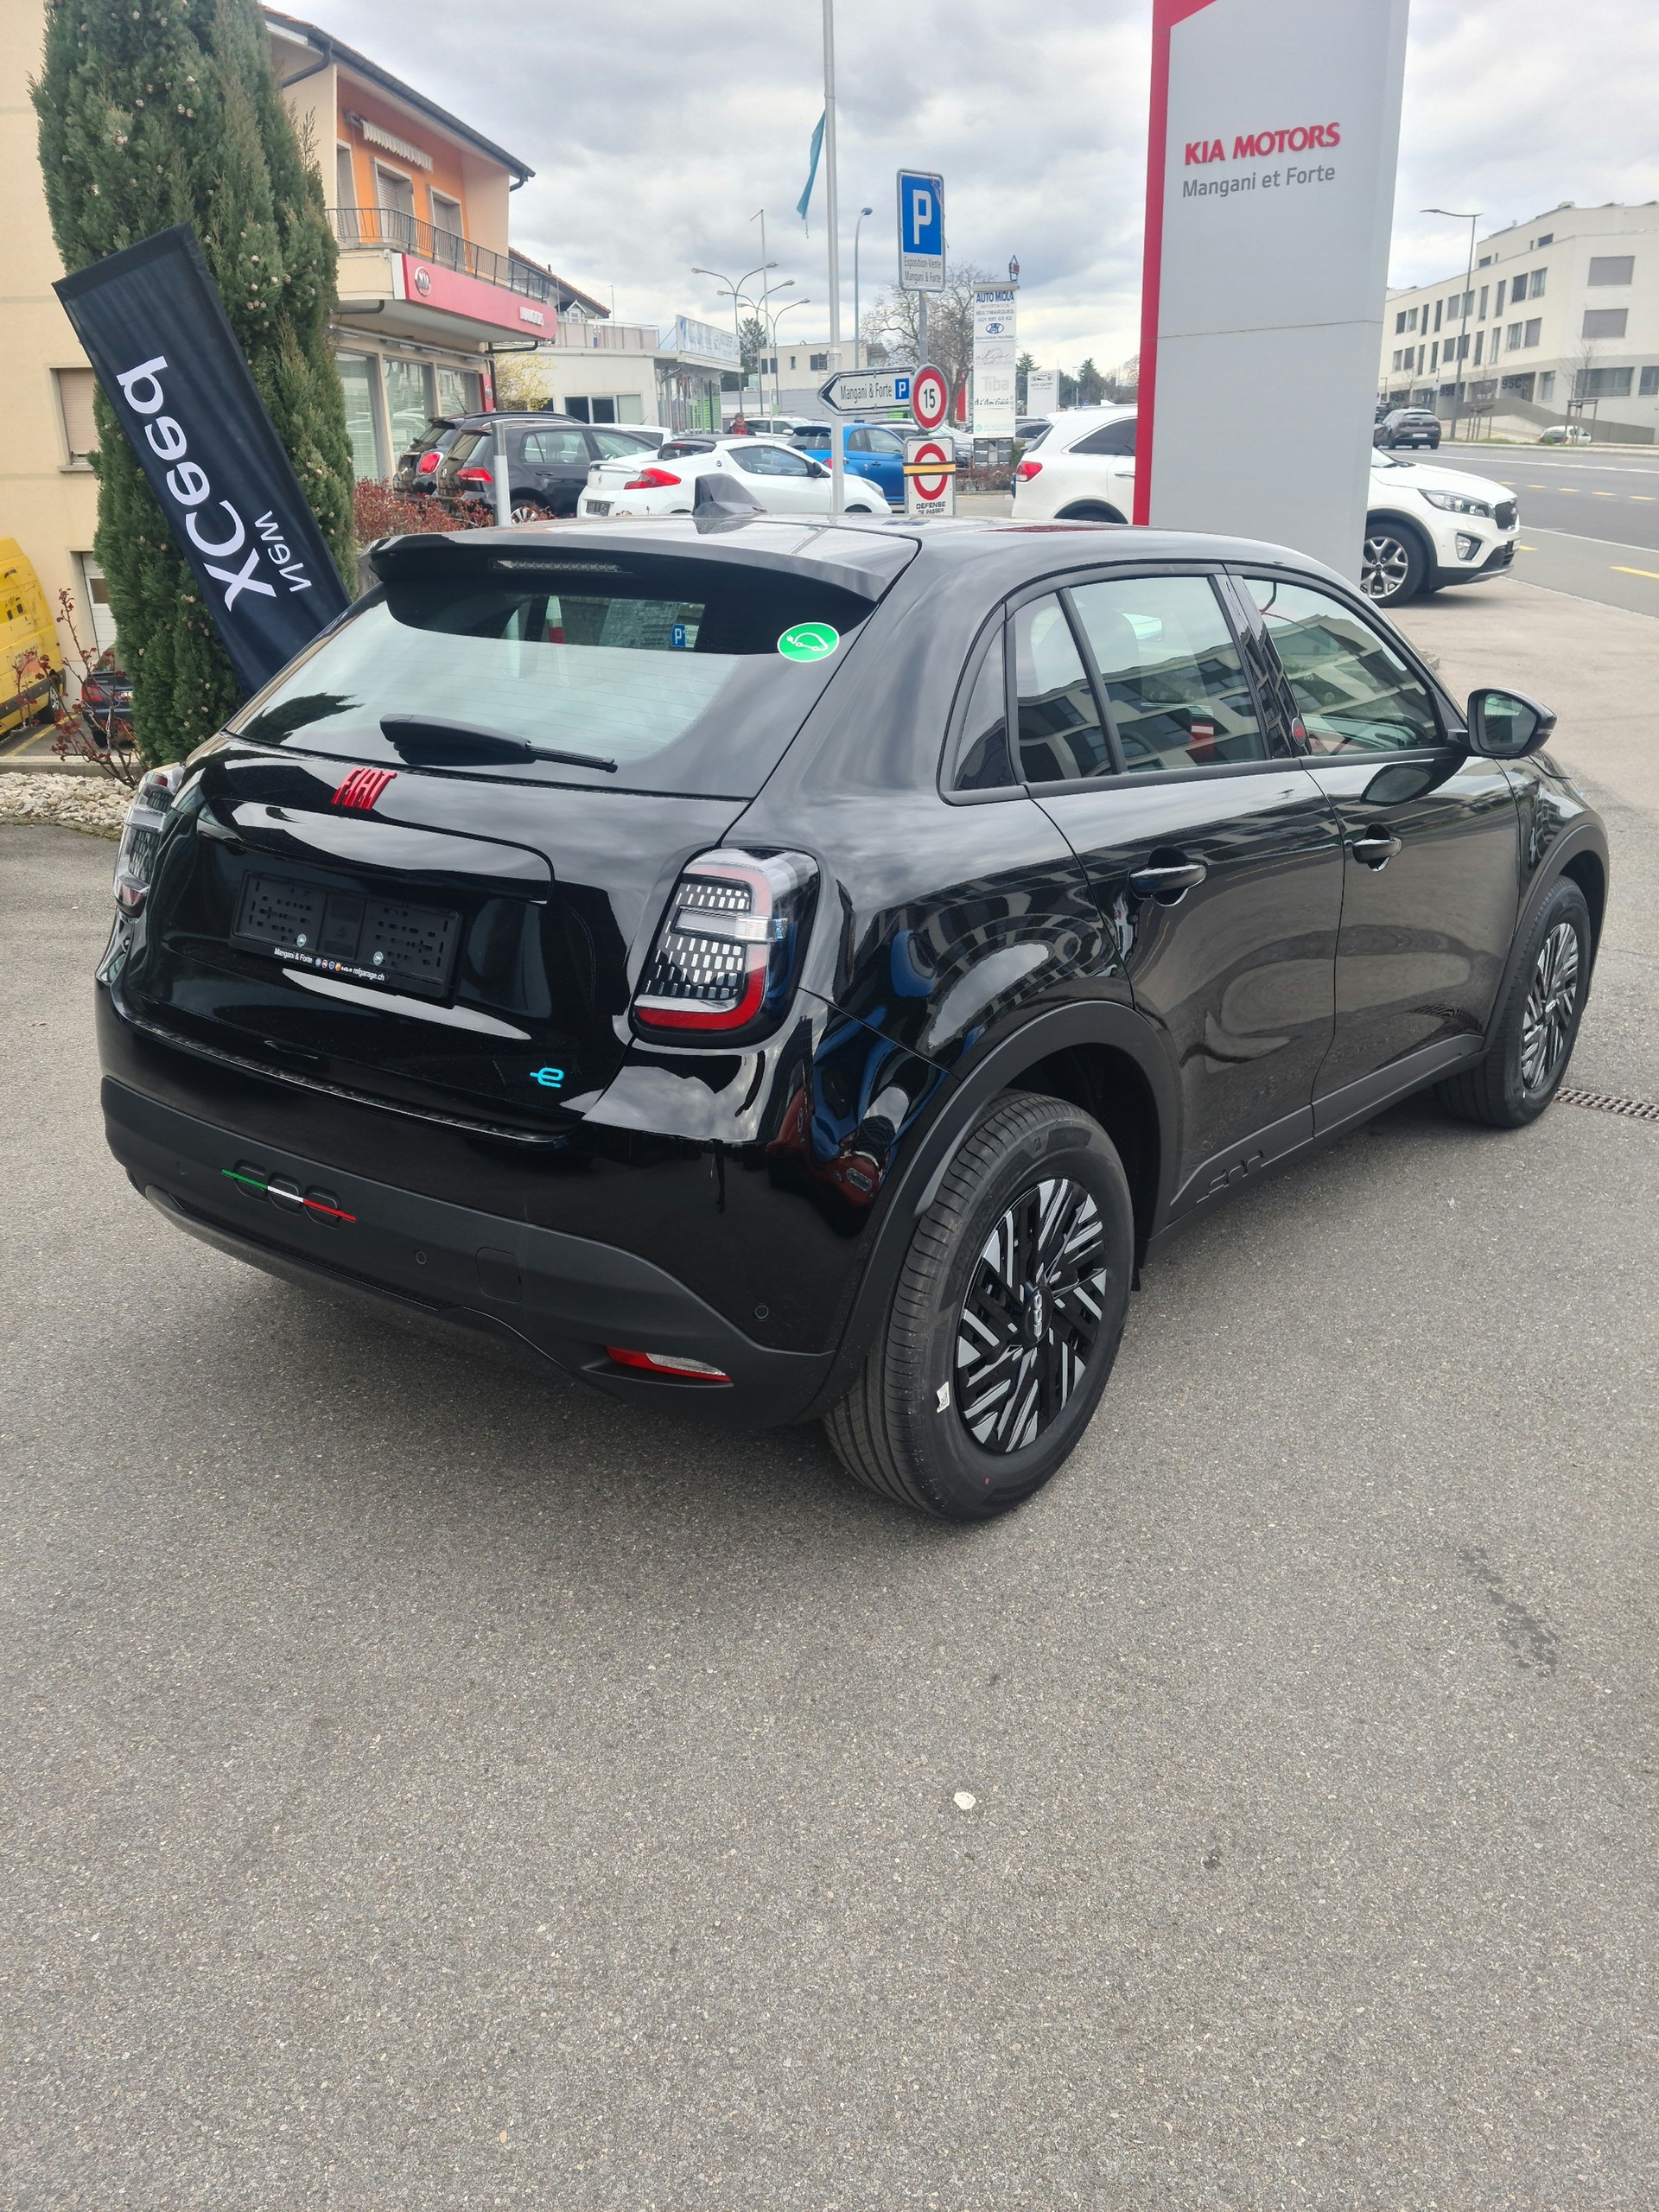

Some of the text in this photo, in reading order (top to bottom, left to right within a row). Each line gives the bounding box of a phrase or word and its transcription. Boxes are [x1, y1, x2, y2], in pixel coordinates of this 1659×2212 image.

[1184, 122, 1341, 166] KIA MOTORS
[1182, 164, 1336, 198] Mangani et Forte
[912, 188, 932, 245] P
[904, 256, 942, 270] Exposition-Vente
[905, 270, 925, 284] Mangani
[930, 272, 942, 283] Forte
[976, 290, 1014, 303] AUTO MIOLA
[840, 381, 906, 404] Mangani & Forte P
[1502, 378, 1522, 390] 95C
[923, 388, 936, 409] 15
[331, 766, 398, 810] FIAT
[274, 947, 295, 960] Mangani
[300, 953, 313, 963] Forte
